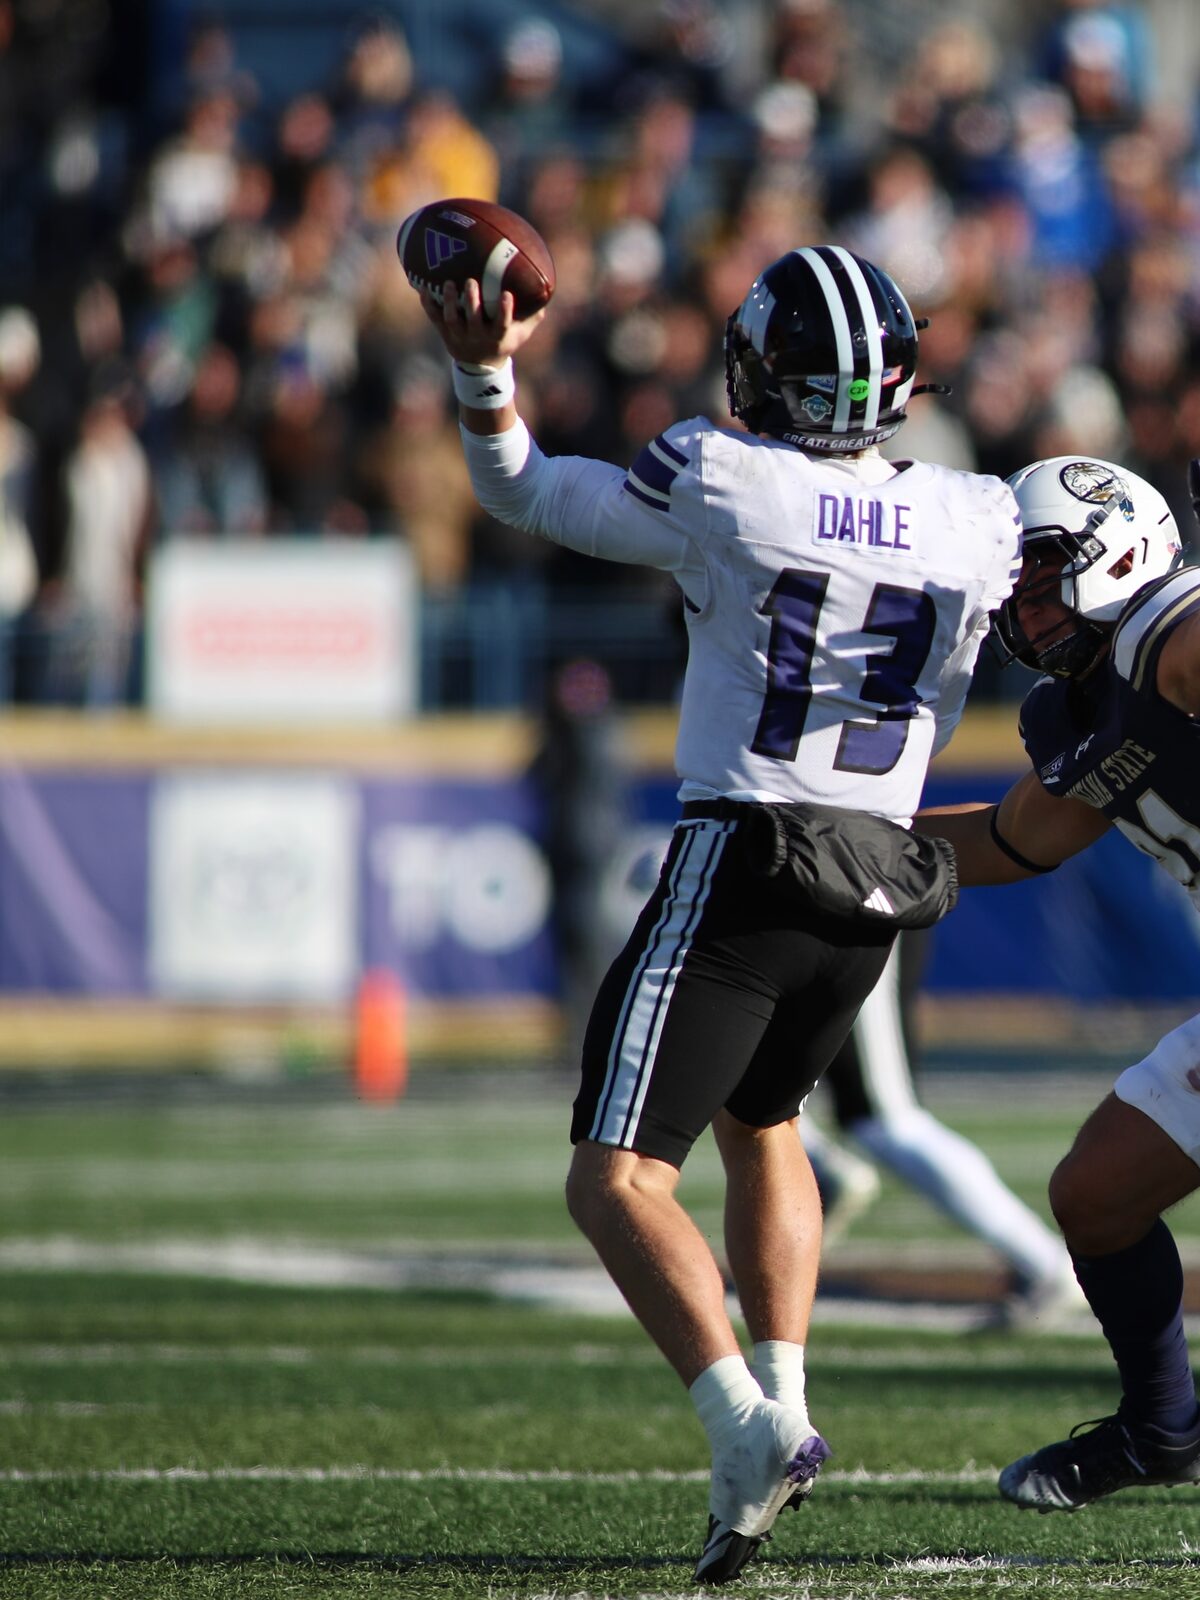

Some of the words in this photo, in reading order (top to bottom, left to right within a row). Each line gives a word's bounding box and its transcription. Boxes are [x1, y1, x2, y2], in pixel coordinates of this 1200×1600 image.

[850, 386, 868, 395] C2P
[783, 432, 825, 448] GREAT!
[829, 436, 874, 449] GREAT!
[818, 493, 911, 551] DAHLE
[750, 567, 937, 776] 13
[1100, 738, 1157, 791] STATE
